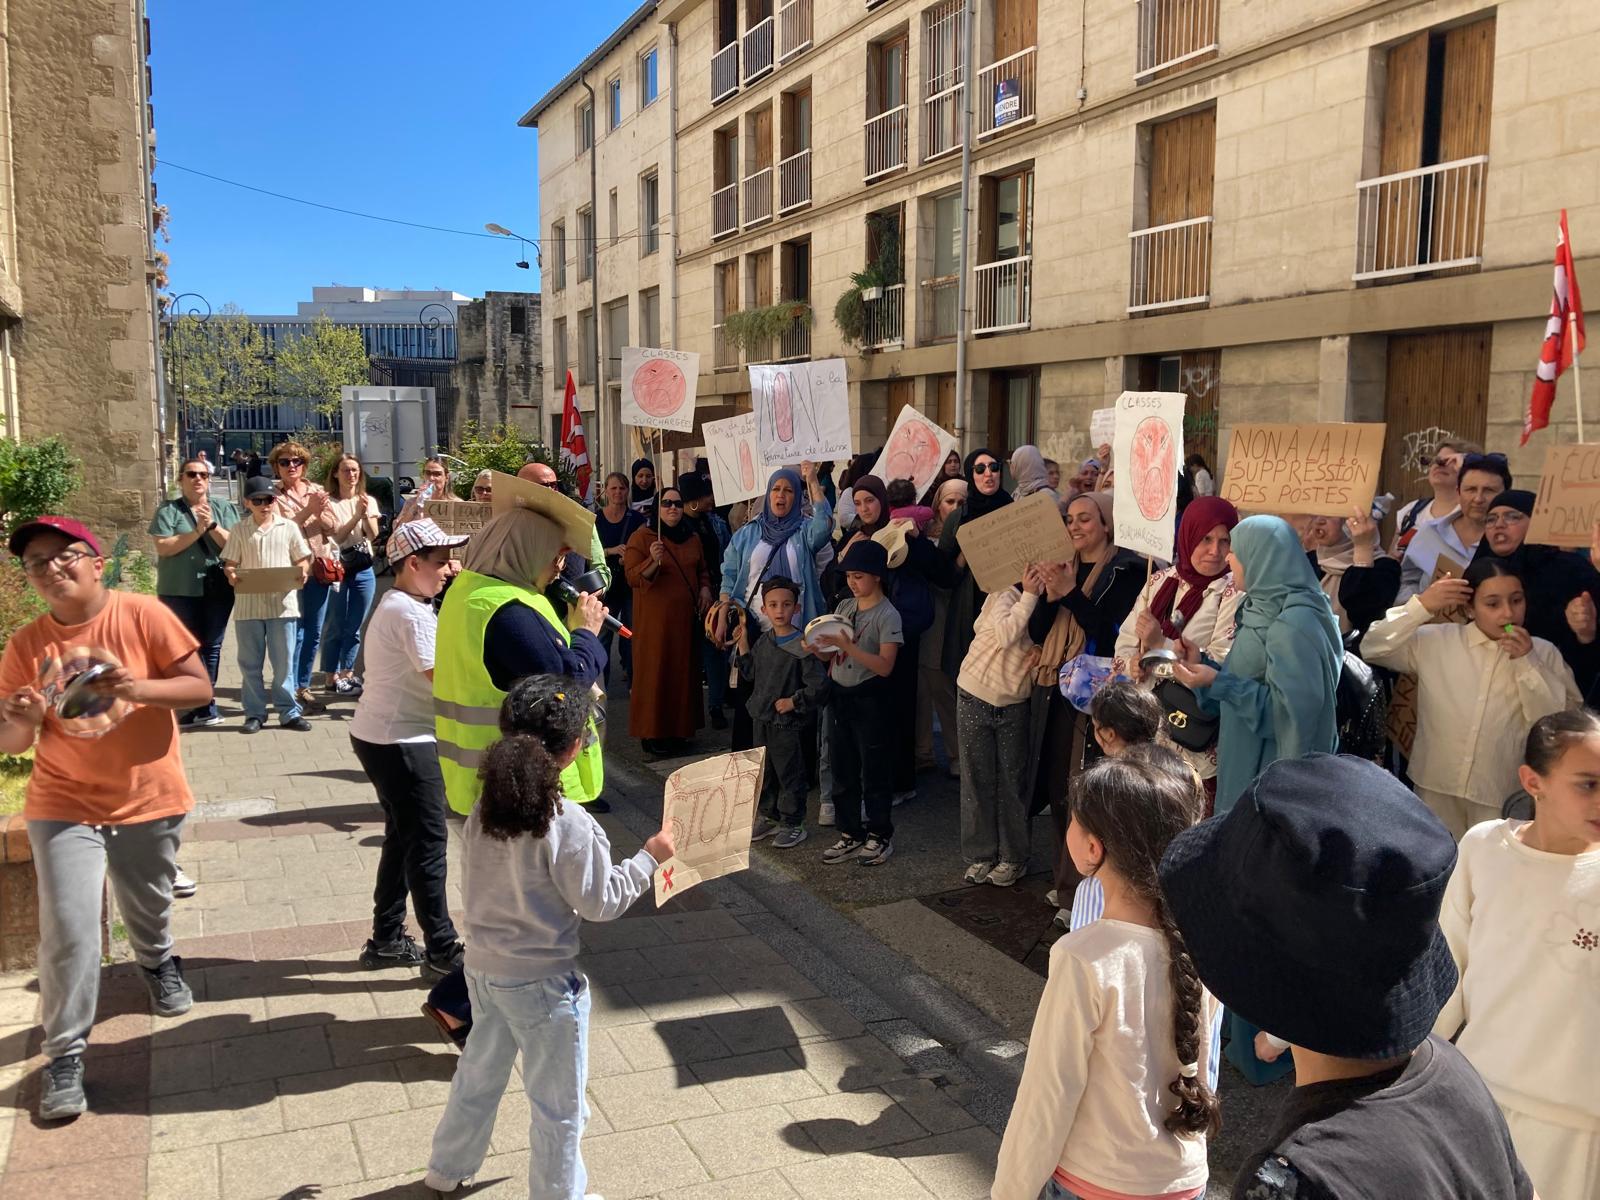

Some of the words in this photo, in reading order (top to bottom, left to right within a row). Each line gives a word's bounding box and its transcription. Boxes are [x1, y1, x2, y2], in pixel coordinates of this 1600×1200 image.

[641, 350, 689, 361] CLASSES
[828, 371, 843, 384] la
[760, 370, 820, 443] NON
[1121, 396, 1162, 410] CLASSES
[805, 445, 817, 456] de
[1232, 429, 1282, 461] NON
[1306, 429, 1331, 463] LA
[1229, 459, 1370, 484] SUPPRESSION
[1226, 483, 1267, 503] DES
[1278, 484, 1352, 504] POSTES
